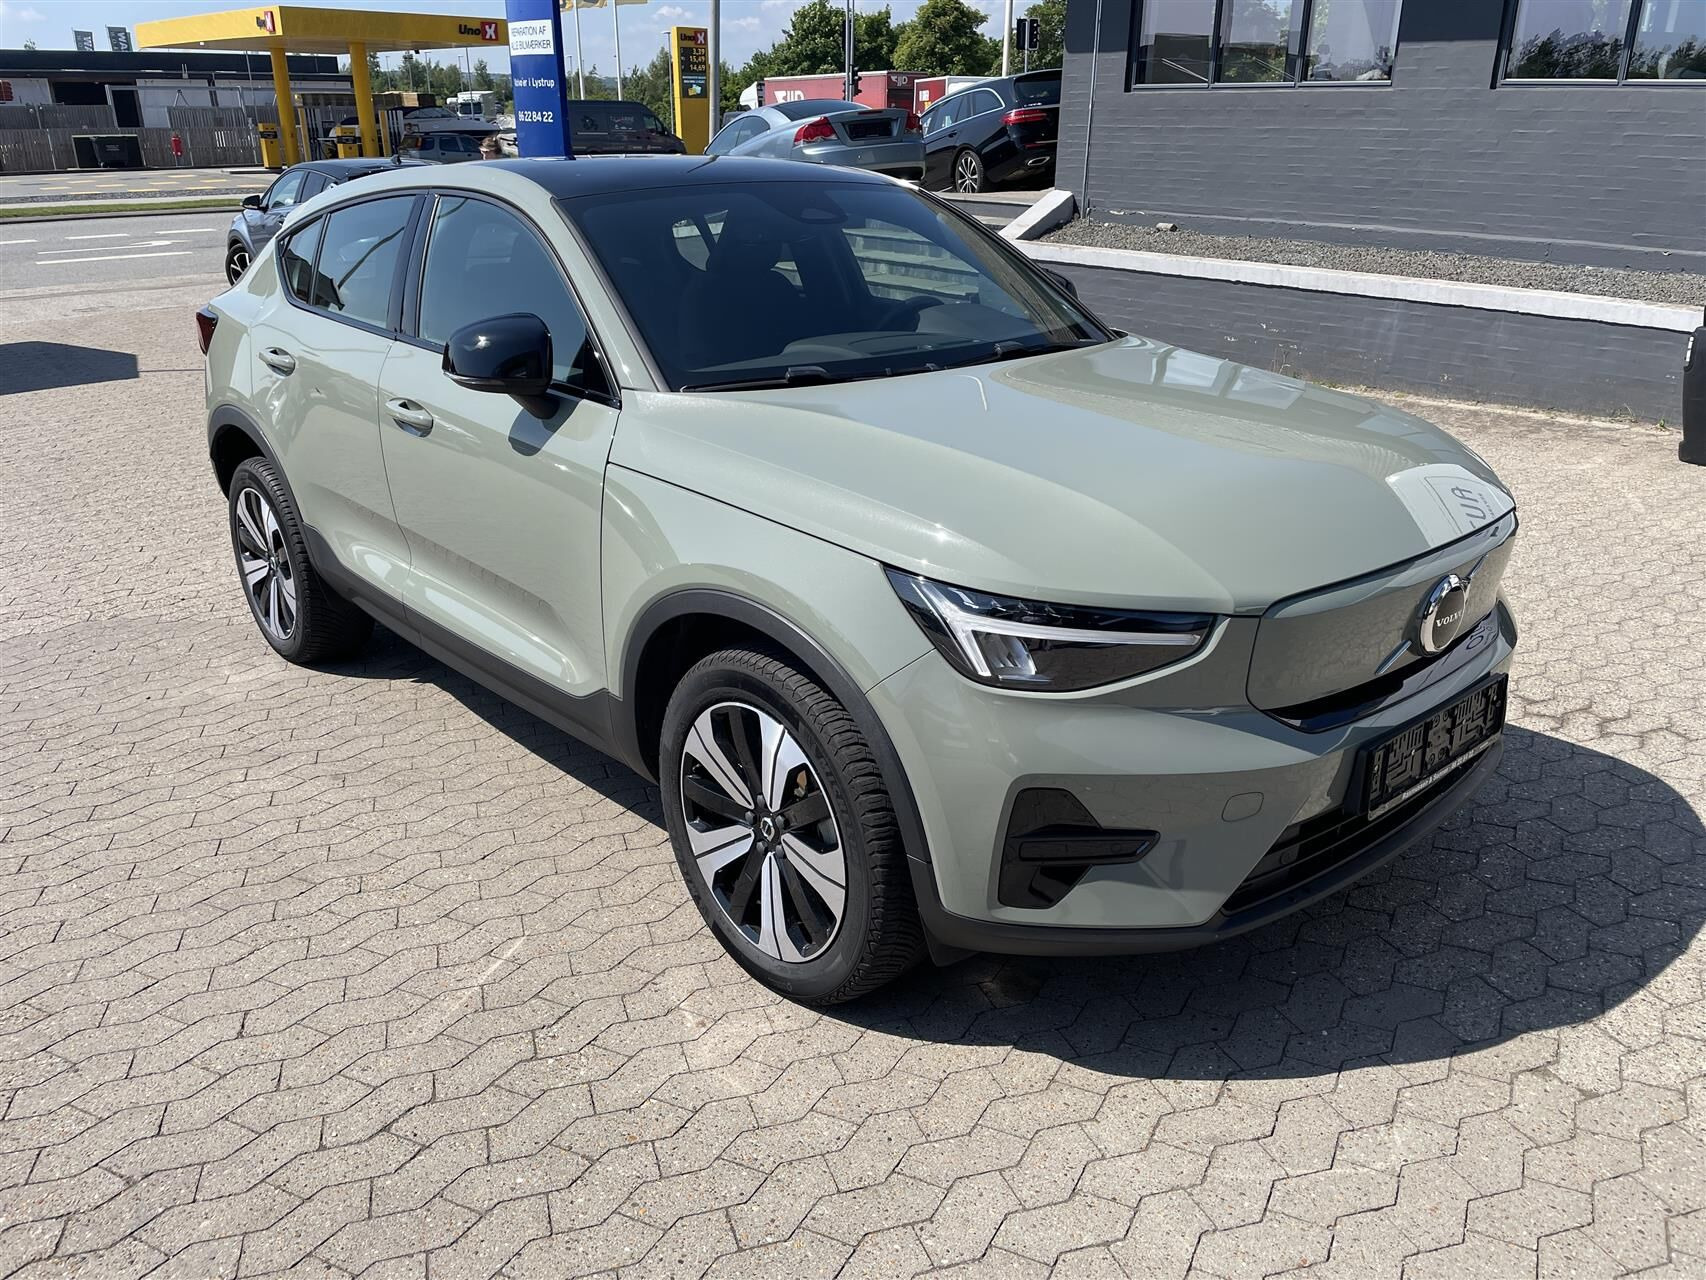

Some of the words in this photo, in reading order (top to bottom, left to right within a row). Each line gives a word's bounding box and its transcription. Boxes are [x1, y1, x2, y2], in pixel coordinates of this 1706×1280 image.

[531, 77, 555, 89] Lystrup
[542, 111, 553, 123] 22
[1436, 609, 1463, 627] VOLV
